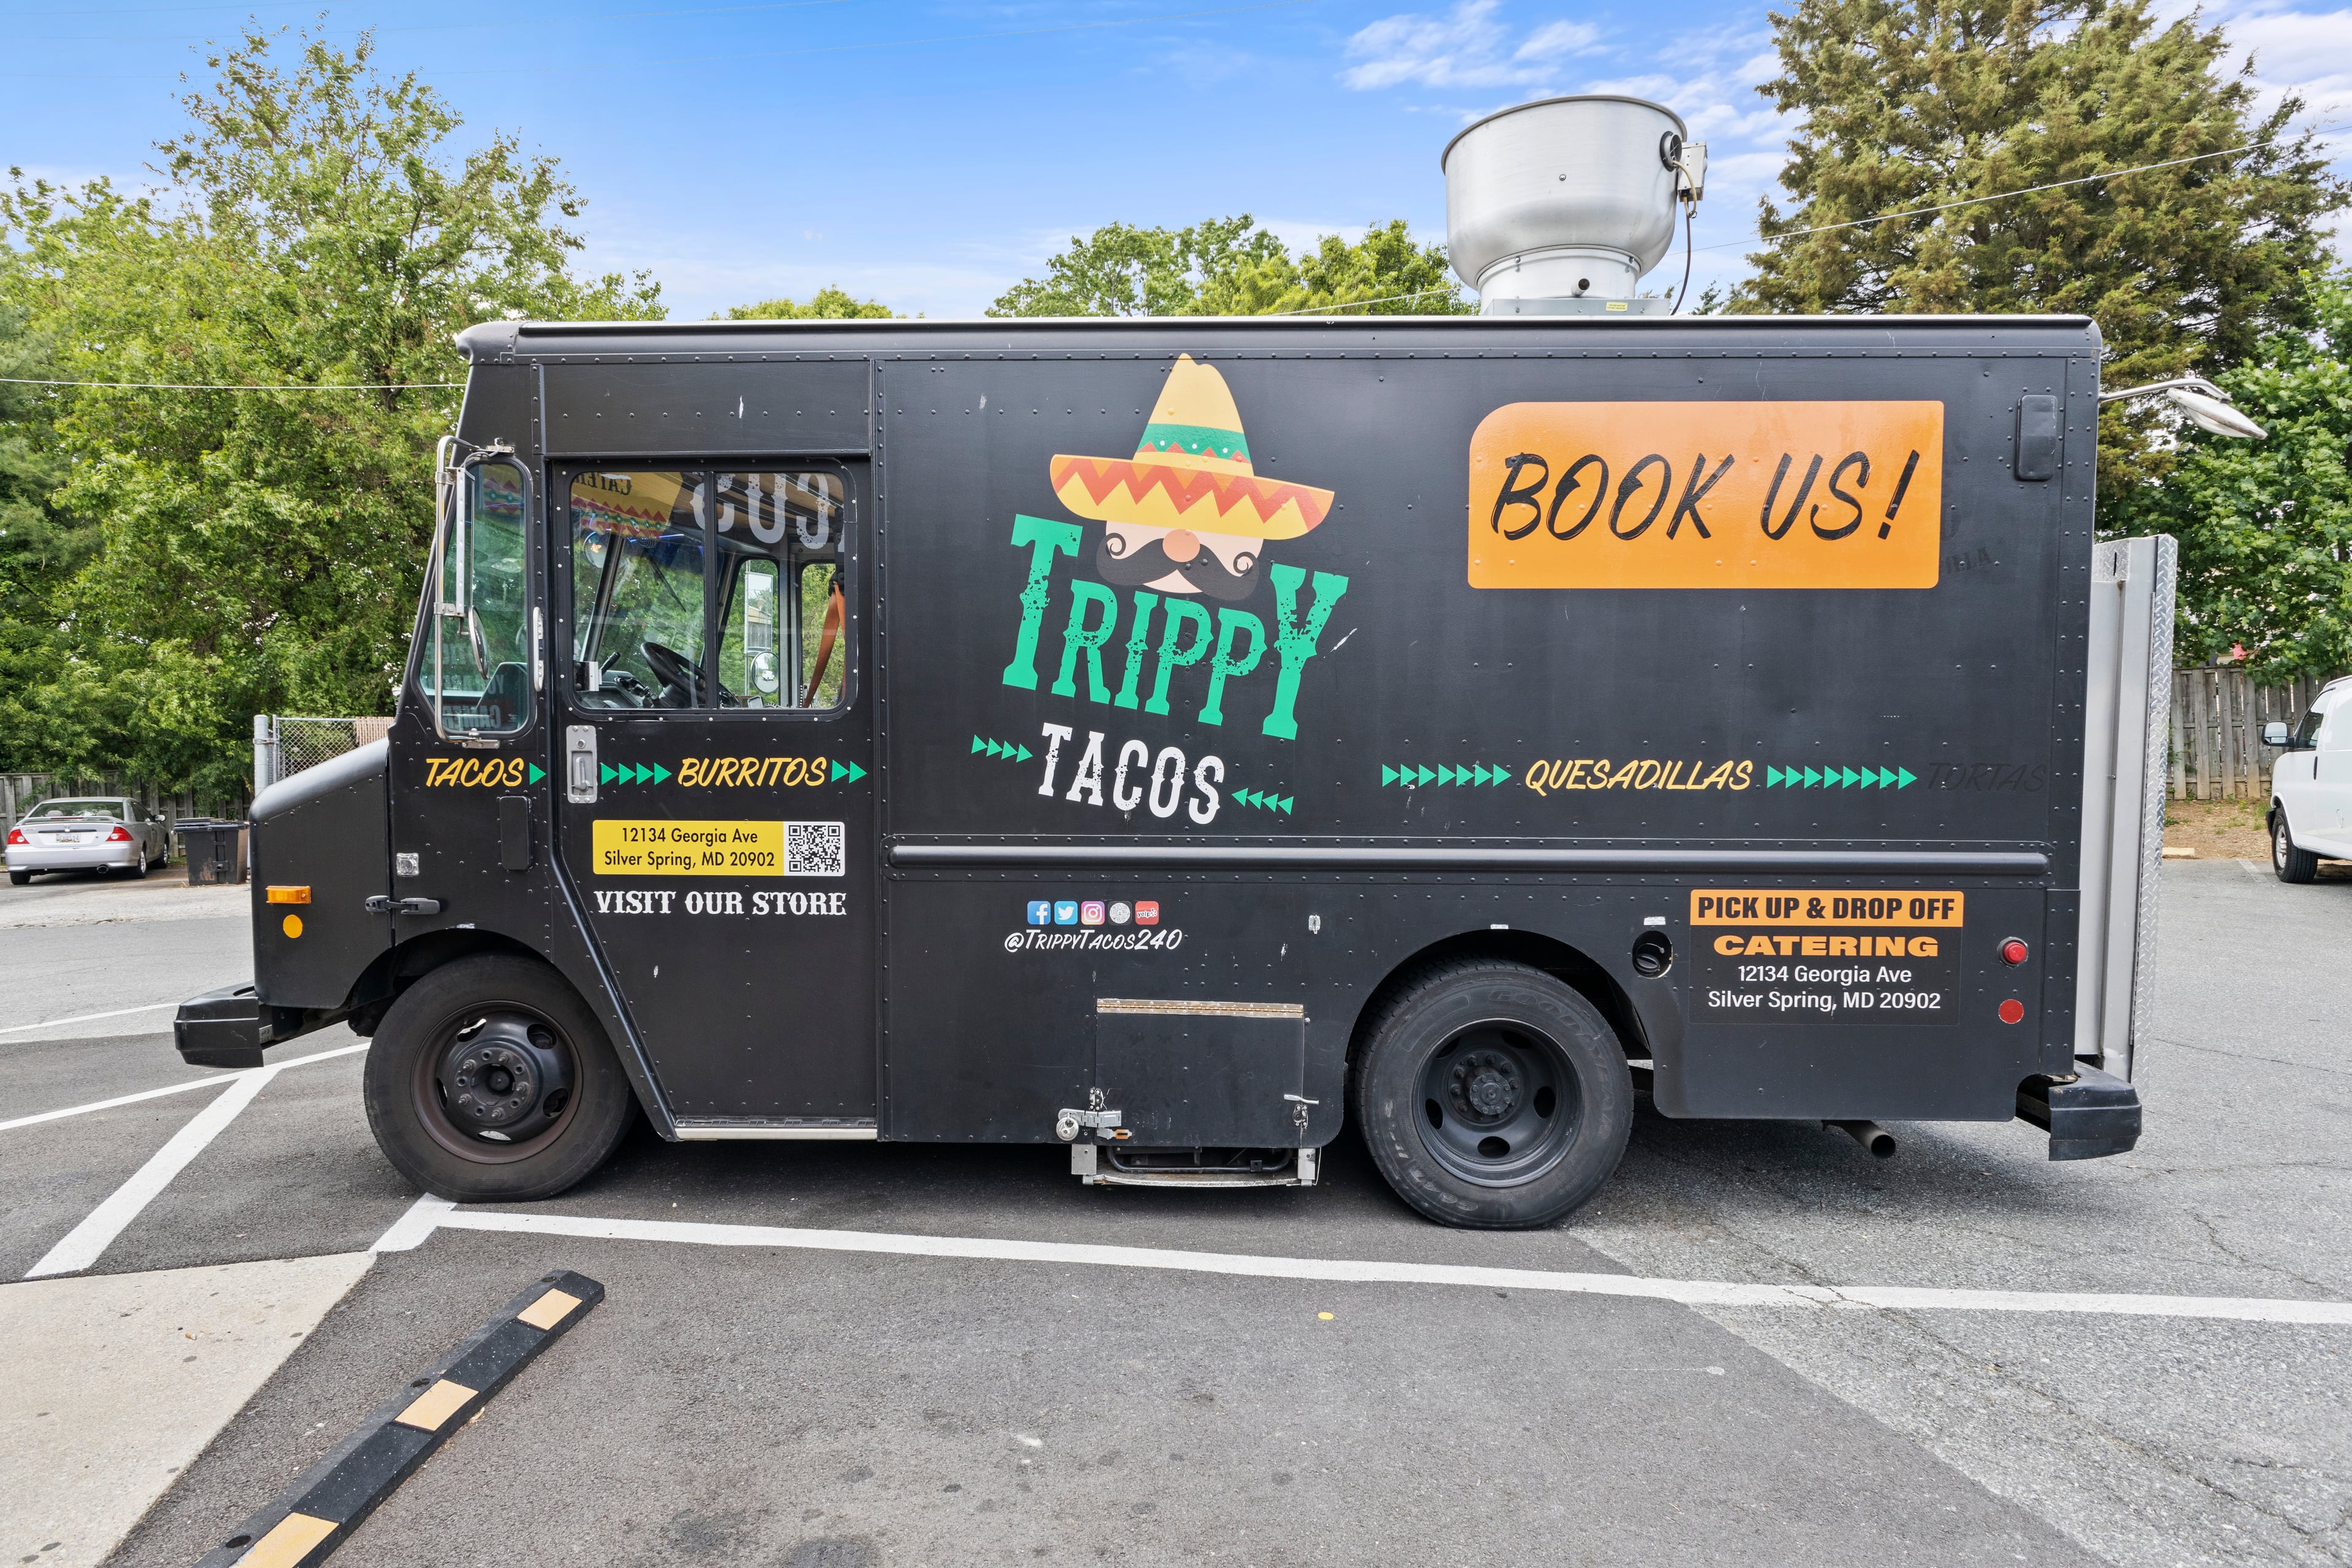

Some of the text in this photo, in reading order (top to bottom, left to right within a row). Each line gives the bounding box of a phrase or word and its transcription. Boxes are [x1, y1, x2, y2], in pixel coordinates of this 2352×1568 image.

[1491, 450, 1920, 540] BOOK US!
[1003, 514, 1349, 740] TRIPPY
[426, 758, 524, 787] TACOS
[677, 757, 827, 787] BURRITOS
[1038, 723, 1224, 824] TACOS
[1525, 759, 1754, 796] QUESADILLAS
[1927, 761, 2047, 792] TORTAS
[622, 827, 758, 847] 12134 Georgia Ave
[605, 849, 775, 870] Silver Spring, MD 20902
[593, 890, 847, 916] VISIT OUR STORE
[1698, 897, 1955, 920] PICK UP & DROP OFF
[1713, 935, 1938, 957] CATERING
[1738, 965, 1912, 986] 12134 Georgia Ave
[1708, 990, 1941, 1012] Silver Spring, MD 20902
